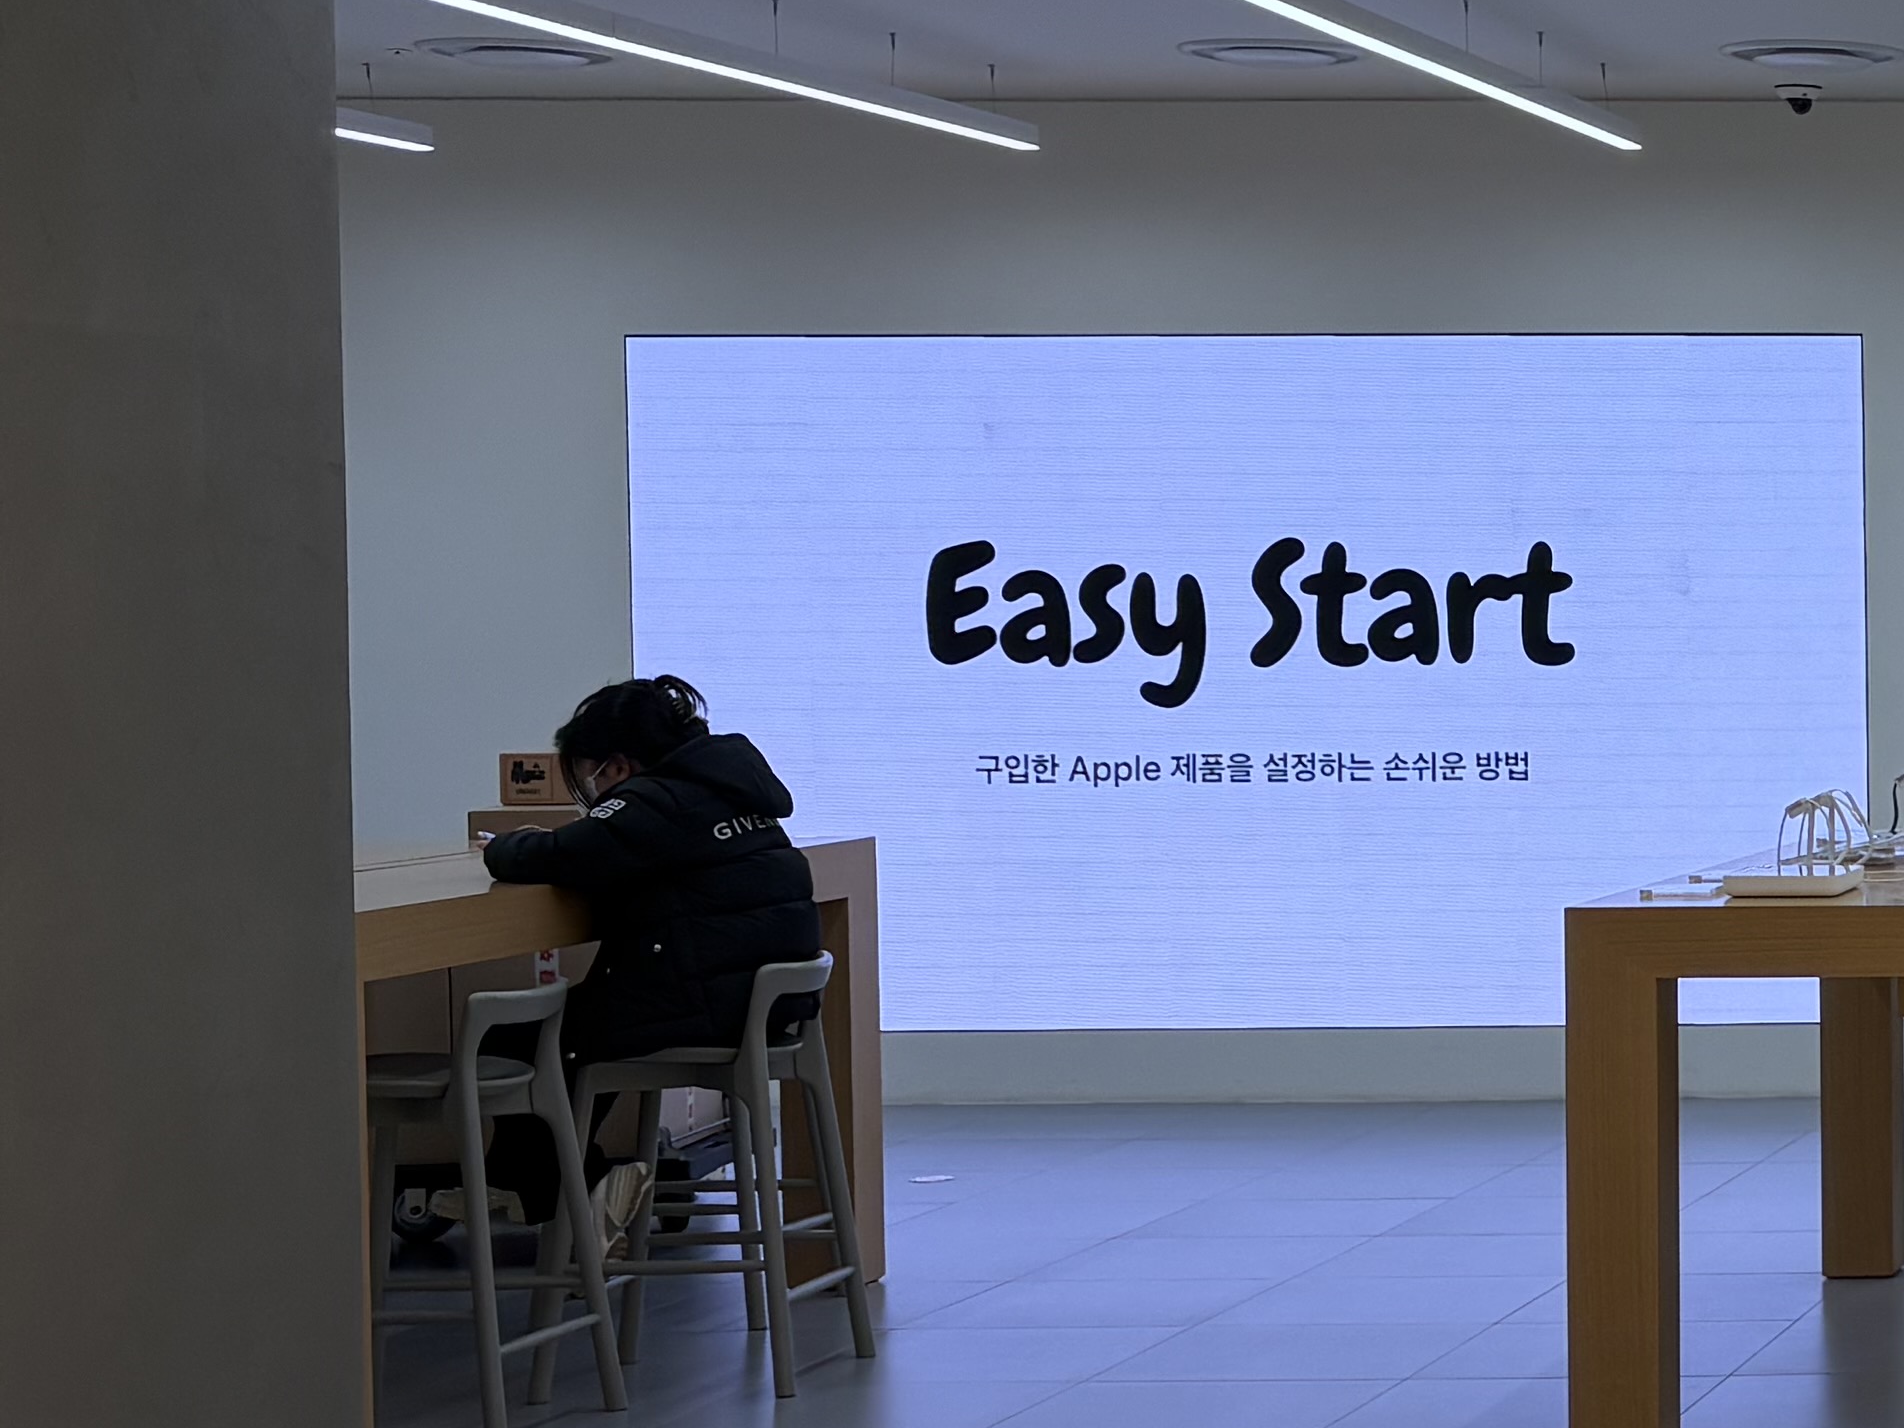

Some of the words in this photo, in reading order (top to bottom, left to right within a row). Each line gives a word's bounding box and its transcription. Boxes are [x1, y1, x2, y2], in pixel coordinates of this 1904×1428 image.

[925, 539, 1207, 709] Easy
[1249, 537, 1576, 668] Start
[975, 753, 1060, 785] 구입한
[1068, 754, 1161, 788] Apple
[1170, 752, 1254, 784] 제품을
[1263, 751, 1375, 783] 설정하는
[1382, 751, 1467, 783] 손쉬운
[1475, 751, 1530, 783] 방법
